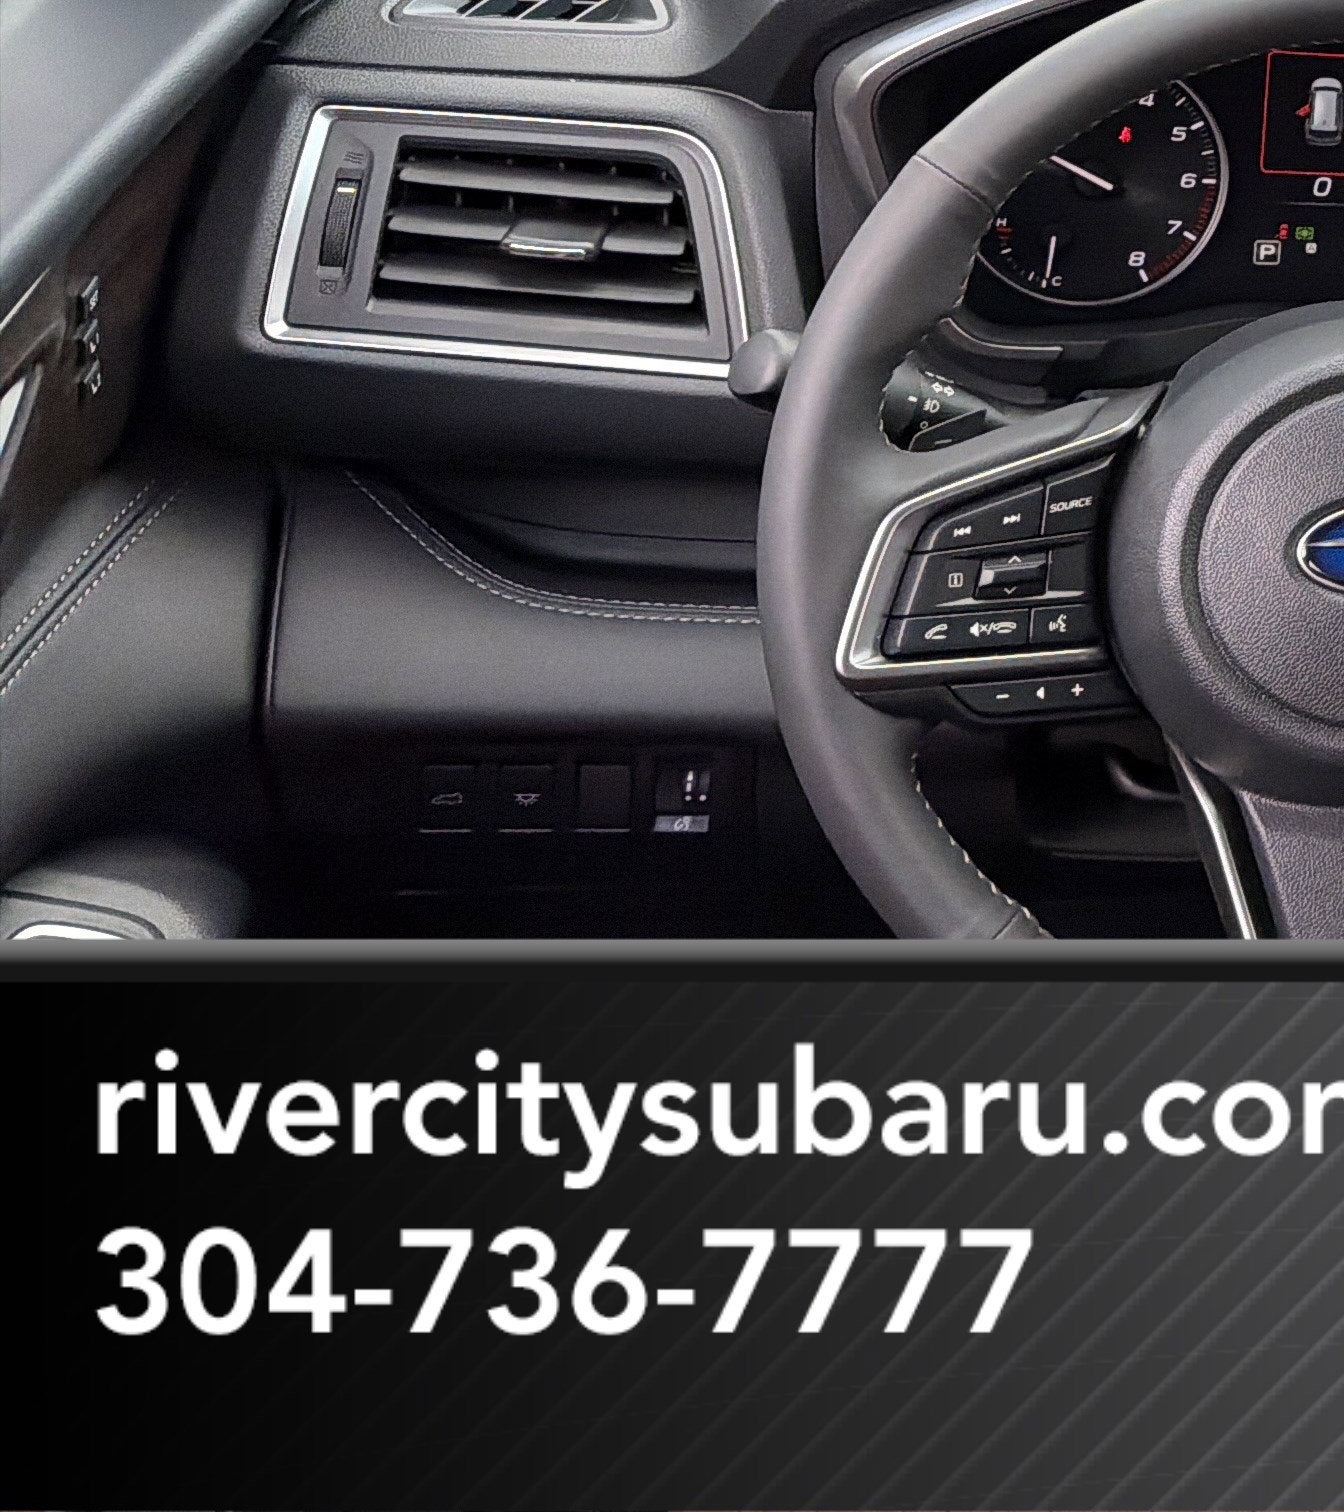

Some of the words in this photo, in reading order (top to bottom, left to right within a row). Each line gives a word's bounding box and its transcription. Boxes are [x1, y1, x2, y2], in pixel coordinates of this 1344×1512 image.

[1138, 93, 1155, 106] 4
[1171, 127, 1187, 141] 5
[1180, 173, 1197, 188] 6
[1313, 177, 1332, 197] 0
[996, 218, 1007, 226] H
[1167, 220, 1182, 234] 7
[1128, 251, 1146, 266] 8
[1260, 244, 1276, 261] P
[1052, 276, 1062, 286] C
[1049, 496, 1093, 514] SOURCE
